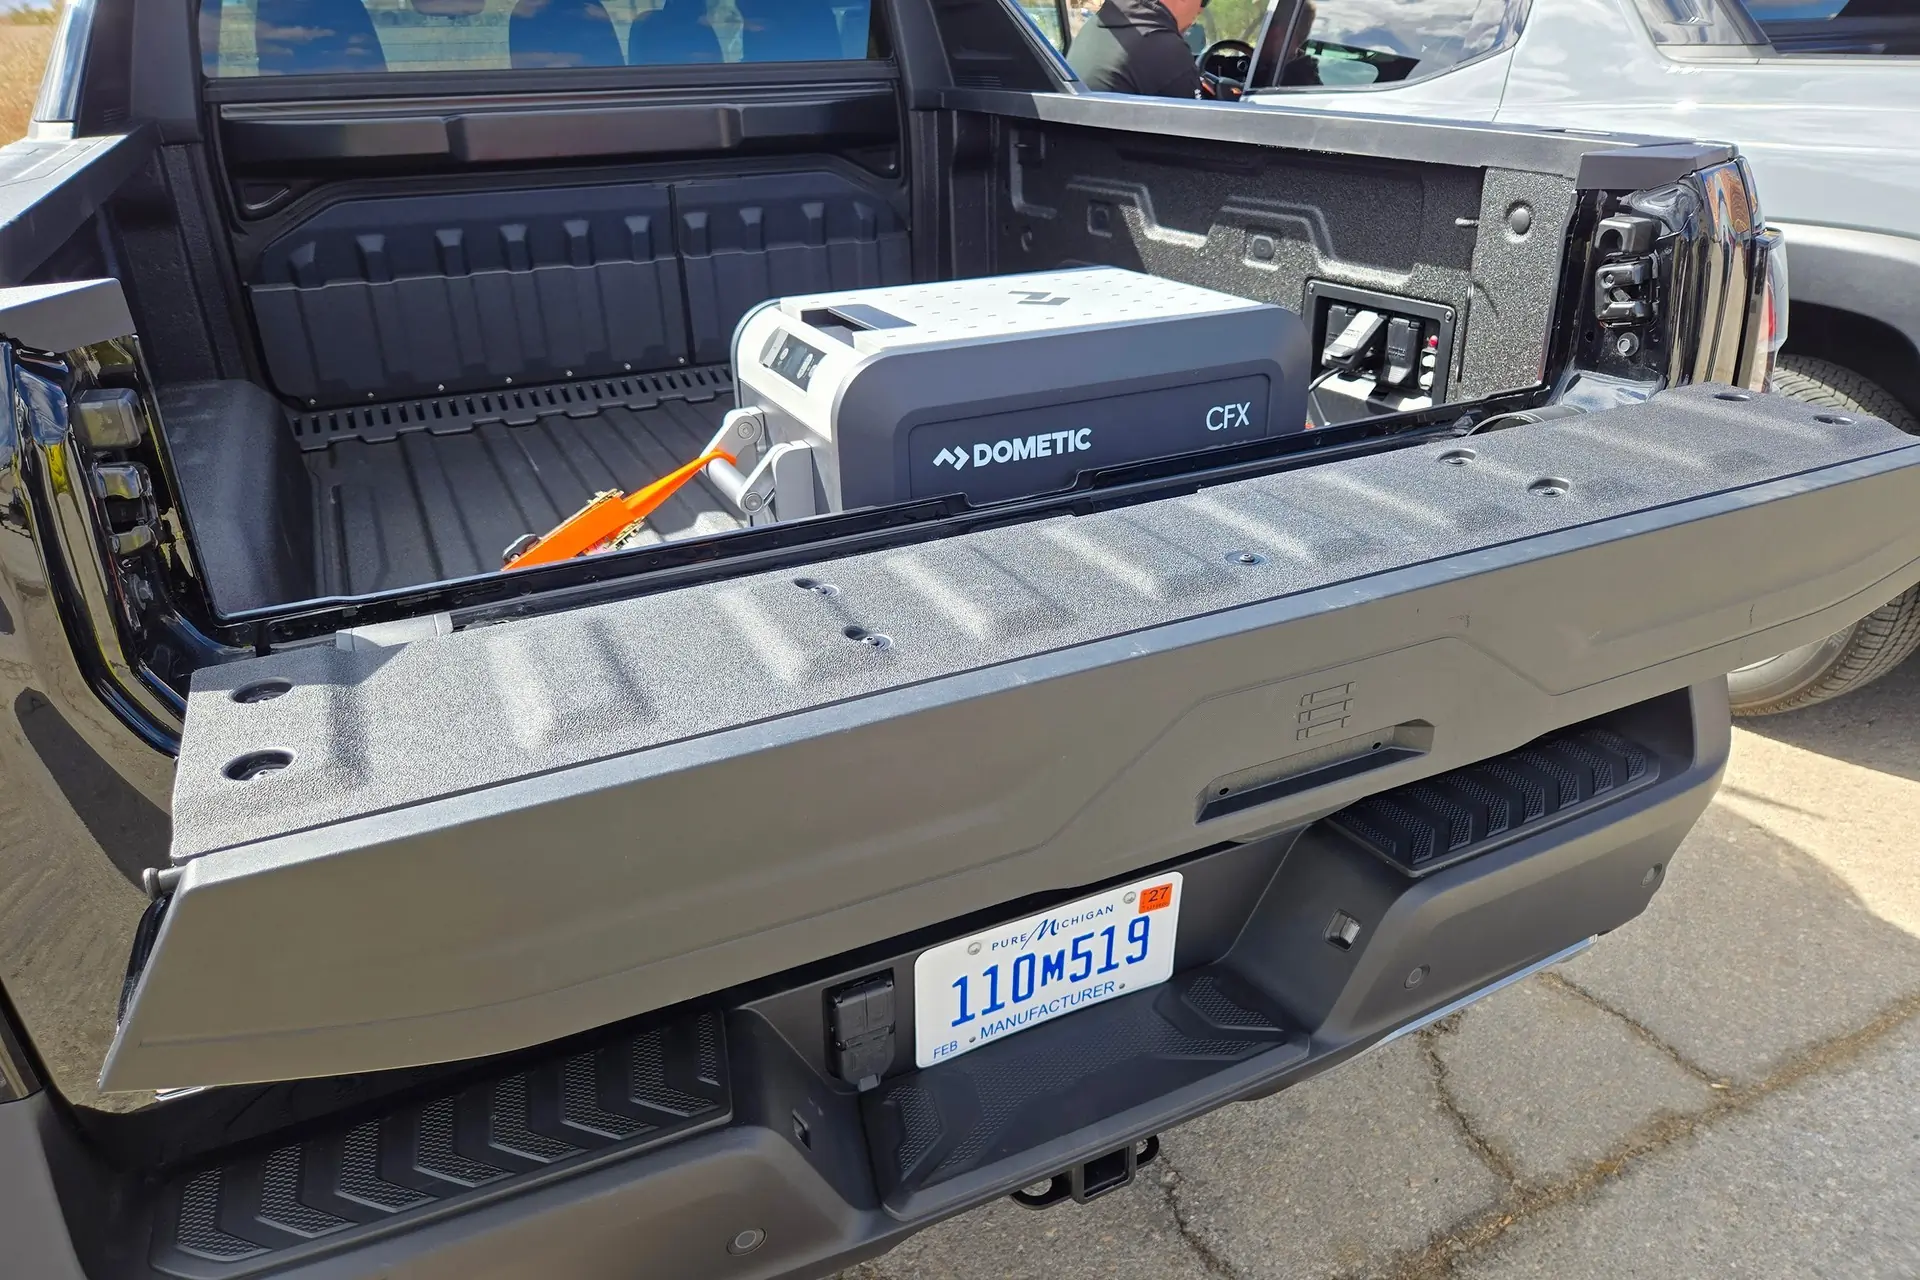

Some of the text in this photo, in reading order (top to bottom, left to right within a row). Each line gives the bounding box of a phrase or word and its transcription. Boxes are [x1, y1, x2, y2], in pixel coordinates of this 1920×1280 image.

[1206, 402, 1250, 431] CFX
[973, 428, 1092, 468] DOMETIC
[1148, 886, 1169, 902] 27
[991, 933, 1028, 951] PURE
[951, 915, 1150, 1027] 110M519
[980, 980, 1115, 1039] MANUFACTURER
[932, 1040, 958, 1059] FEB
